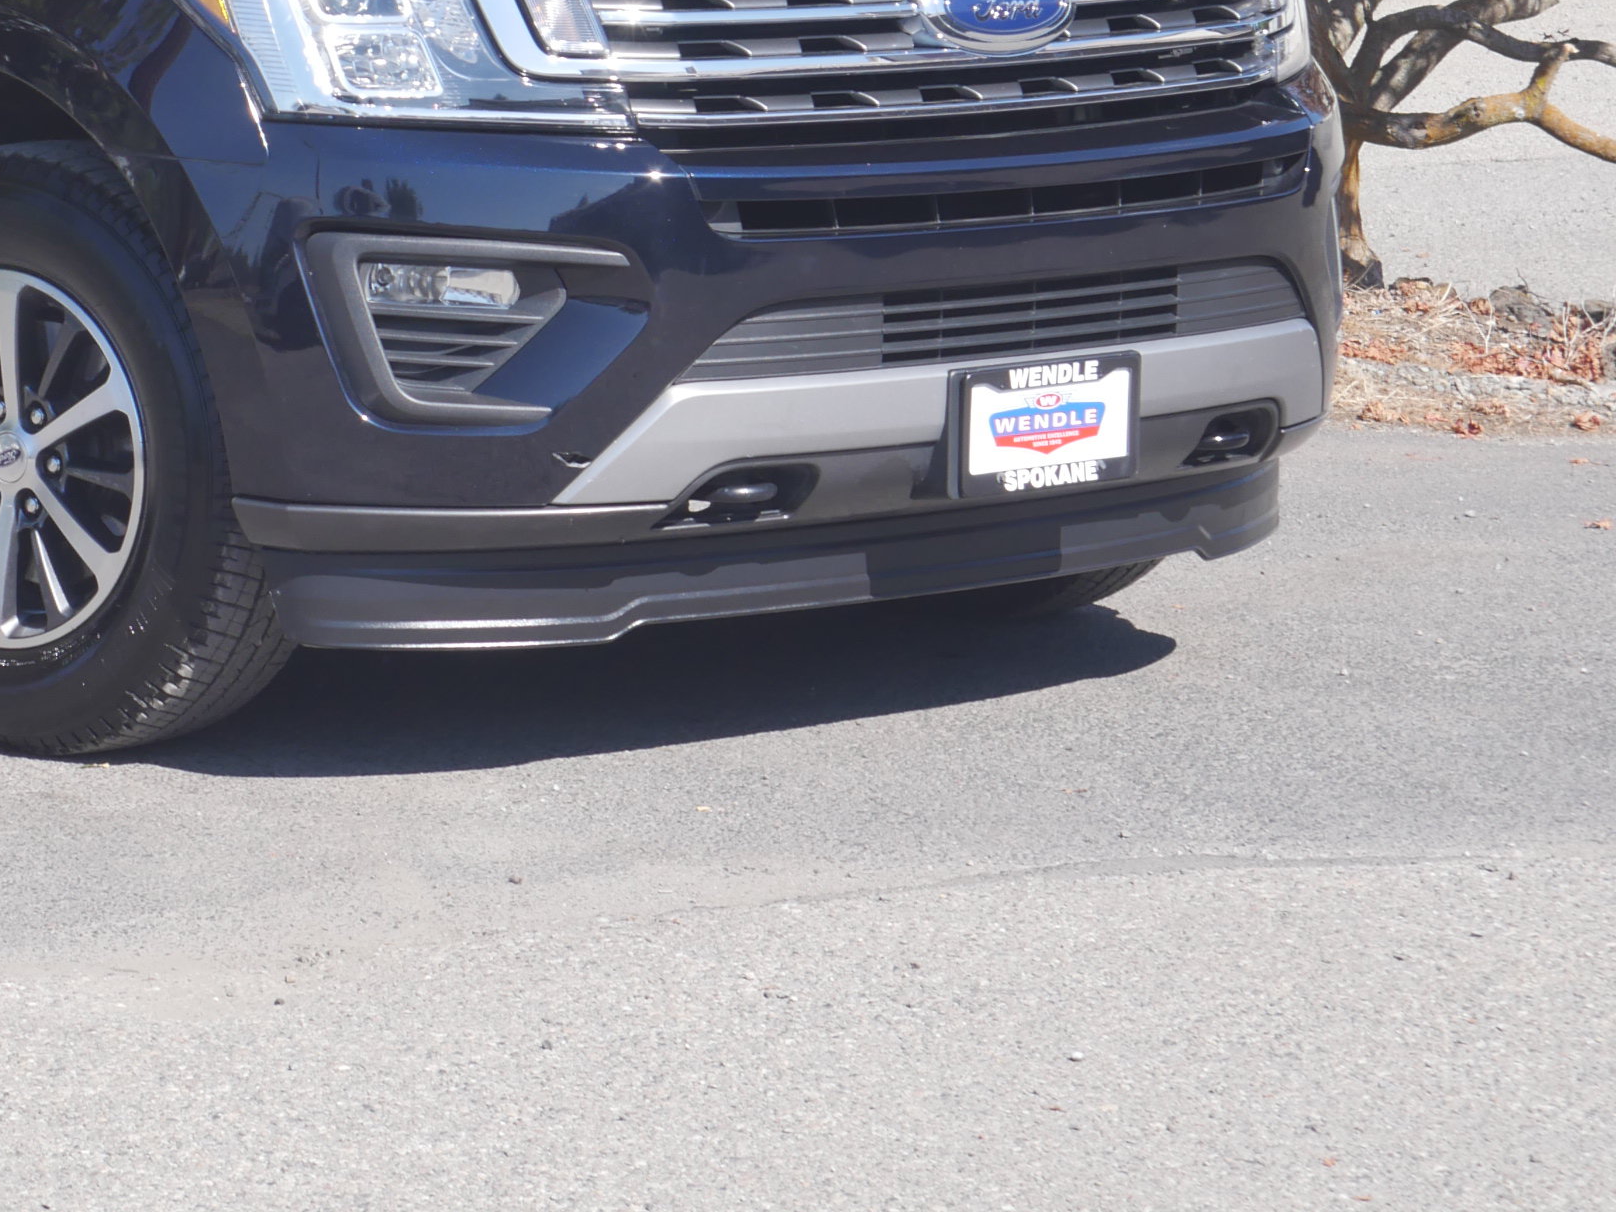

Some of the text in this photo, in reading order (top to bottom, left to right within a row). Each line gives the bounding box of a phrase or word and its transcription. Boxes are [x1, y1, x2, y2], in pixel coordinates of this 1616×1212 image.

[1009, 360, 1099, 389] WENDLE
[994, 408, 1097, 434] WENDLE
[1004, 460, 1099, 491] SPOKANE
